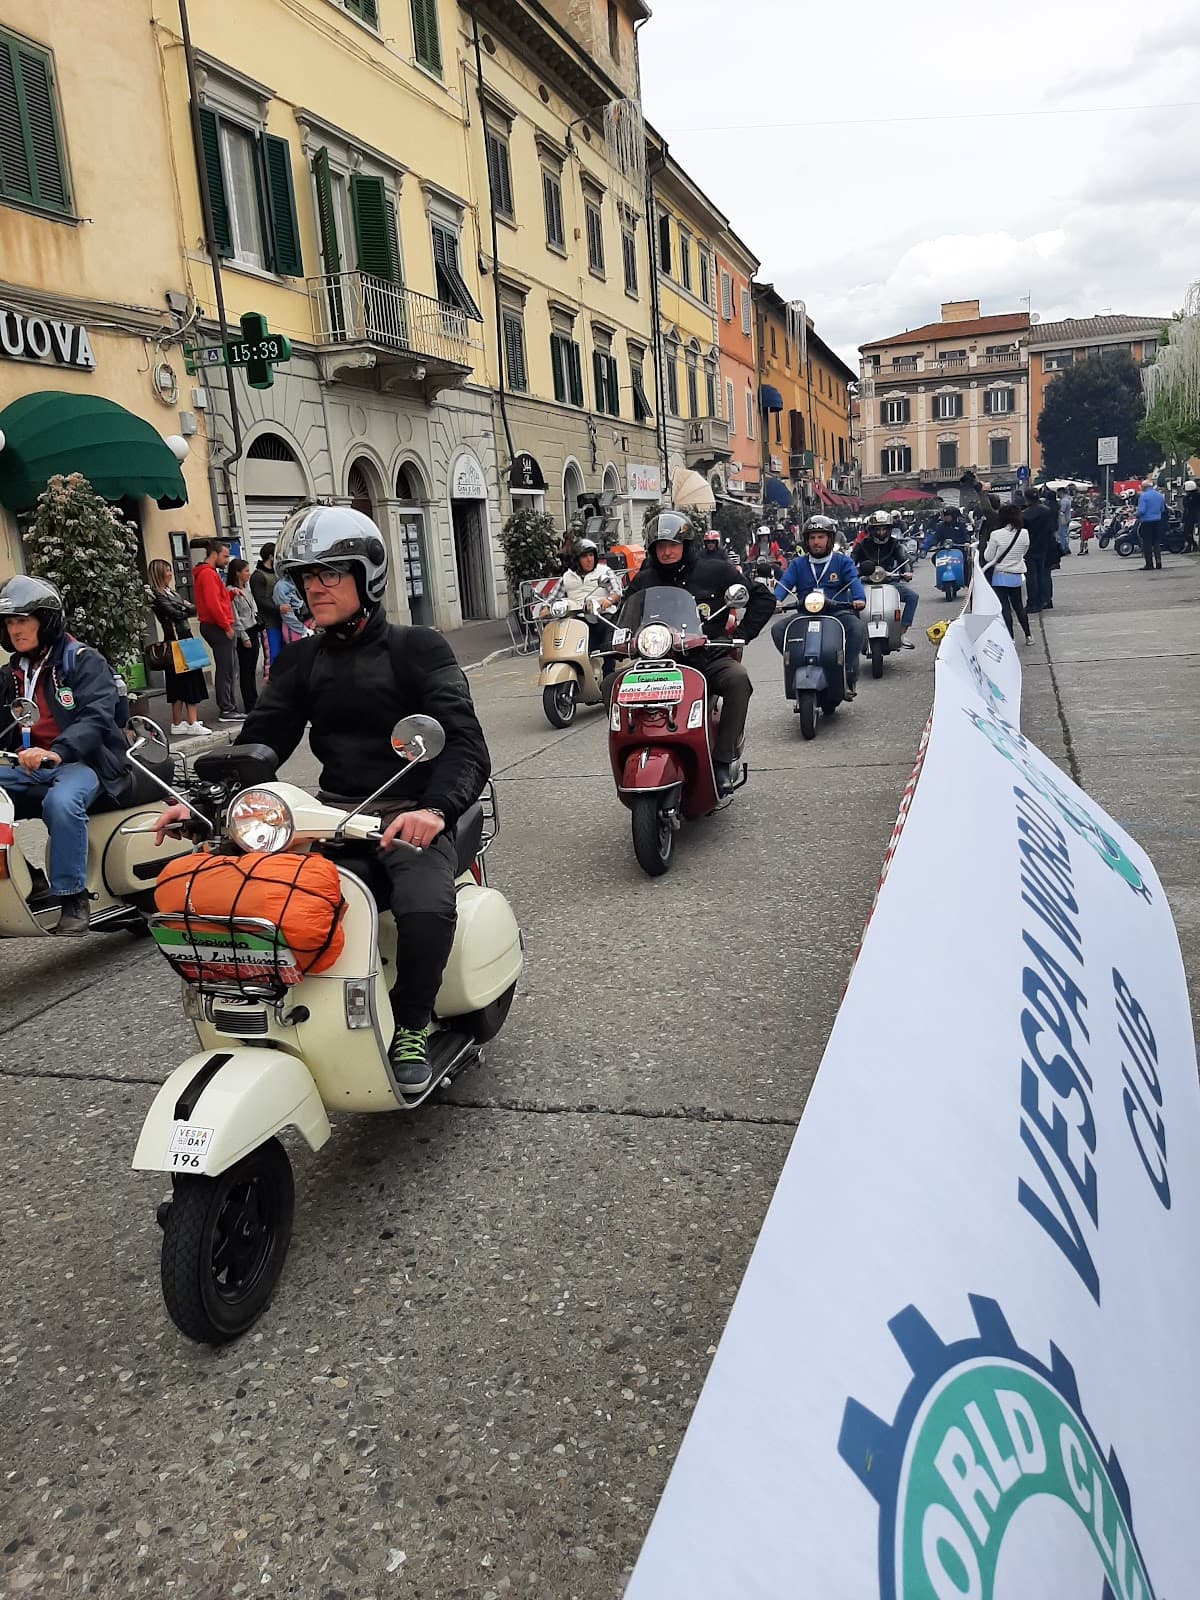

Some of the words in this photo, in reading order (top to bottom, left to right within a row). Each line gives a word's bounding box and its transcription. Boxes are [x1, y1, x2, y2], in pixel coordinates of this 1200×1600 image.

[231, 340, 279, 362] 15:39
[1012, 786, 1084, 966] WORLD
[1112, 967, 1171, 1210] CLUB
[1018, 928, 1100, 1308] VESPA
[180, 1128, 207, 1139] VESPA
[187, 1137, 206, 1147] DAY
[172, 1153, 200, 1167] 196
